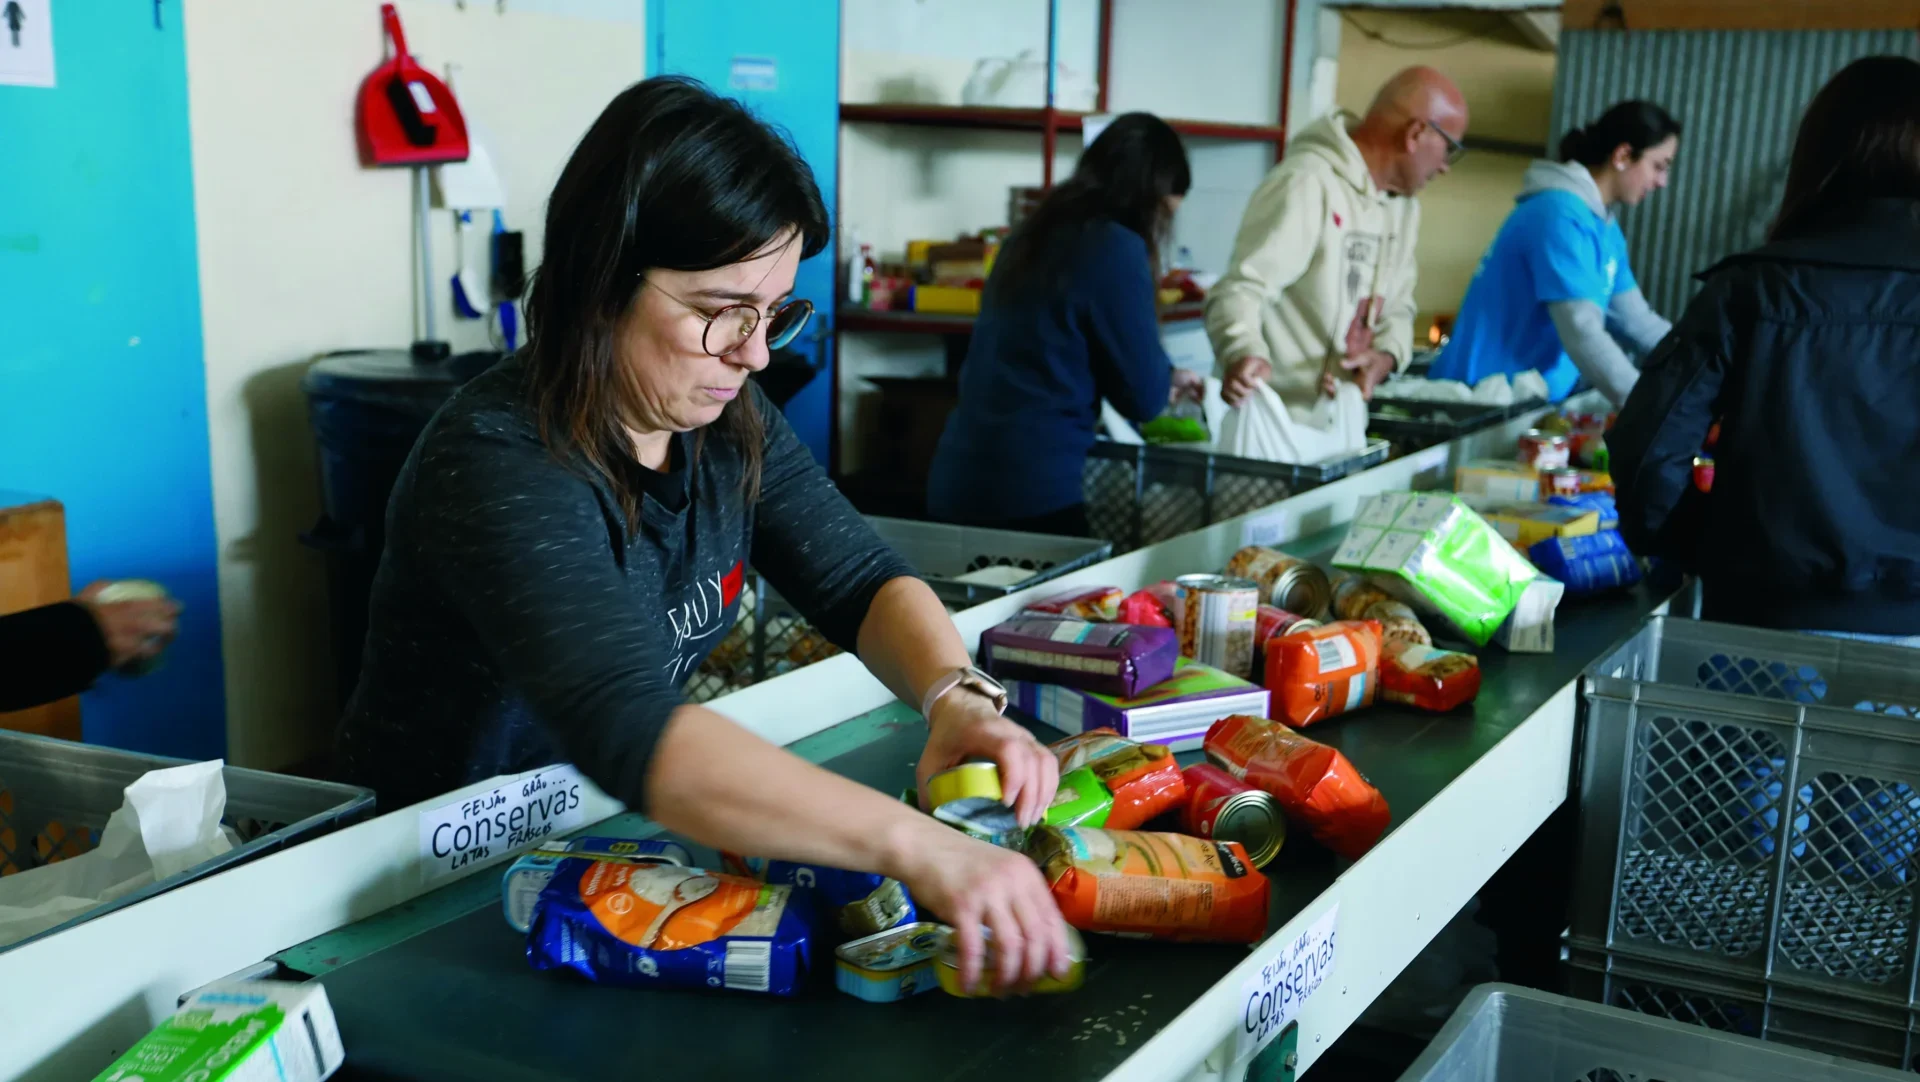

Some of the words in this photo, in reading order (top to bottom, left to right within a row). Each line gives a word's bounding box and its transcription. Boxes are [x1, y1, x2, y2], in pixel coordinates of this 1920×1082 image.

[431, 784, 580, 858] Conservas
[450, 845, 490, 870] LATAS
[507, 821, 552, 849] FRASCOS
[1245, 931, 1336, 1034] Conservas
[1256, 1008, 1285, 1043] LATAS
